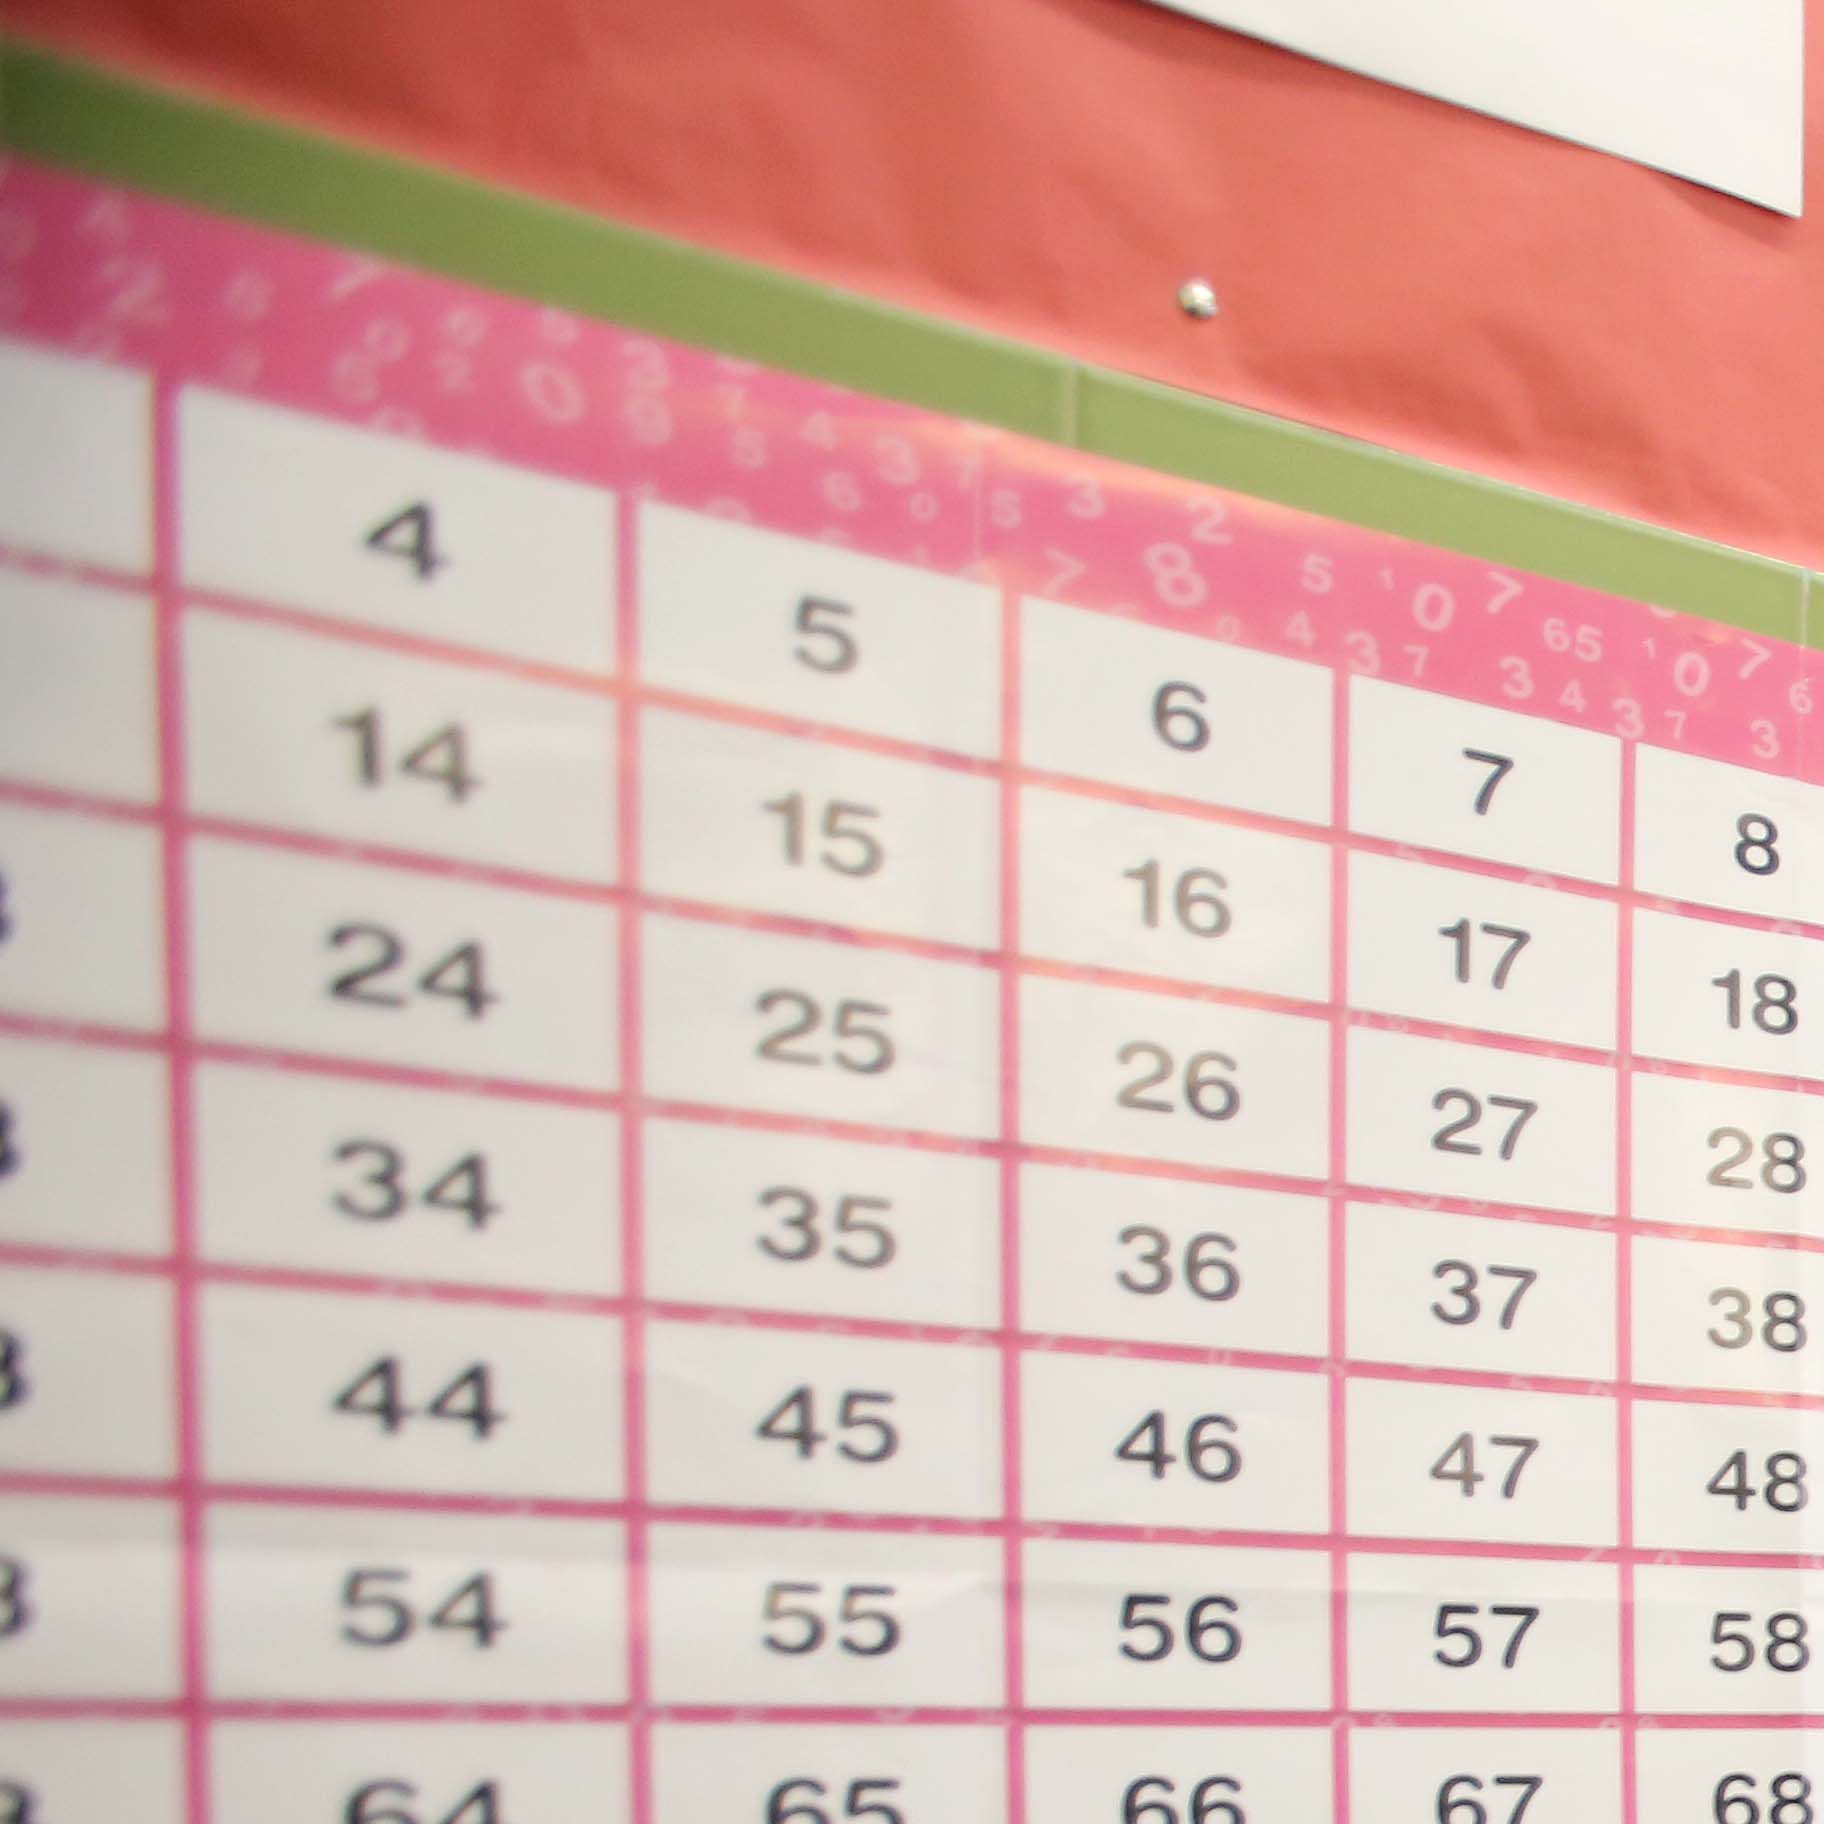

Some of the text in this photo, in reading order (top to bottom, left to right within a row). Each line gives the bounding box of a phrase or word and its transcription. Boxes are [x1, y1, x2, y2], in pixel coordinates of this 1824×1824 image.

[363, 500, 446, 583] 4
[791, 592, 861, 677] 5
[1150, 680, 1212, 755] 6
[1462, 747, 1515, 817] 7
[1733, 812, 1782, 878] 8
[333, 705, 480, 805] 14
[760, 790, 887, 881] 15
[1123, 858, 1234, 940] 16
[1438, 917, 1532, 991] 17
[1712, 968, 1800, 1037] 18
[326, 921, 497, 1021] 24
[752, 986, 898, 1078] 25
[1116, 1041, 1243, 1124] 26
[1430, 1086, 1539, 1162] 27
[1707, 1127, 1808, 1196] 28
[332, 1138, 499, 1232] 34
[755, 1184, 899, 1272] 35
[1116, 1224, 1243, 1305] 36
[1430, 1258, 1538, 1331] 37
[1707, 1287, 1808, 1356] 38
[332, 1354, 504, 1441] 44
[754, 1384, 901, 1466] 45
[1114, 1409, 1243, 1485] 46
[1428, 1431, 1541, 1501] 47
[1705, 1448, 1807, 1515] 48
[340, 1567, 507, 1651] 54
[762, 1581, 903, 1660] 55
[1119, 1591, 1244, 1666] 56
[1433, 1601, 1541, 1670] 57
[1710, 1610, 1811, 1675] 58
